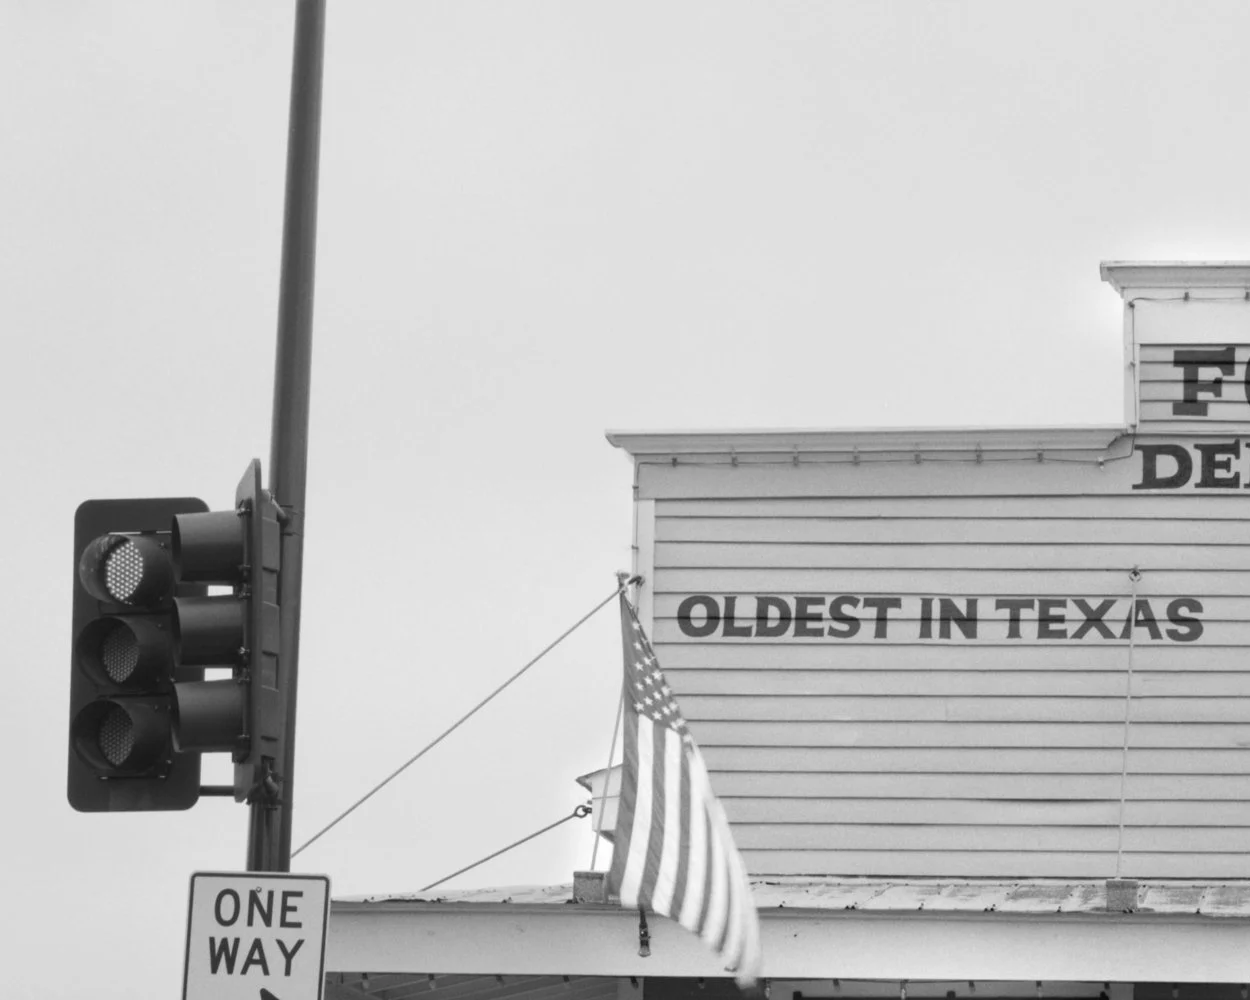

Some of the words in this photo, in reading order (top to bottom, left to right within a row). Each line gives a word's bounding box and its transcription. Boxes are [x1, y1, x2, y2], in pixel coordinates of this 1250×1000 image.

[676, 595, 901, 639] OLDEST
[919, 598, 979, 640] IN
[995, 598, 1204, 643] TEXAS
[214, 888, 303, 928] ONE
[209, 936, 305, 977] WAY
